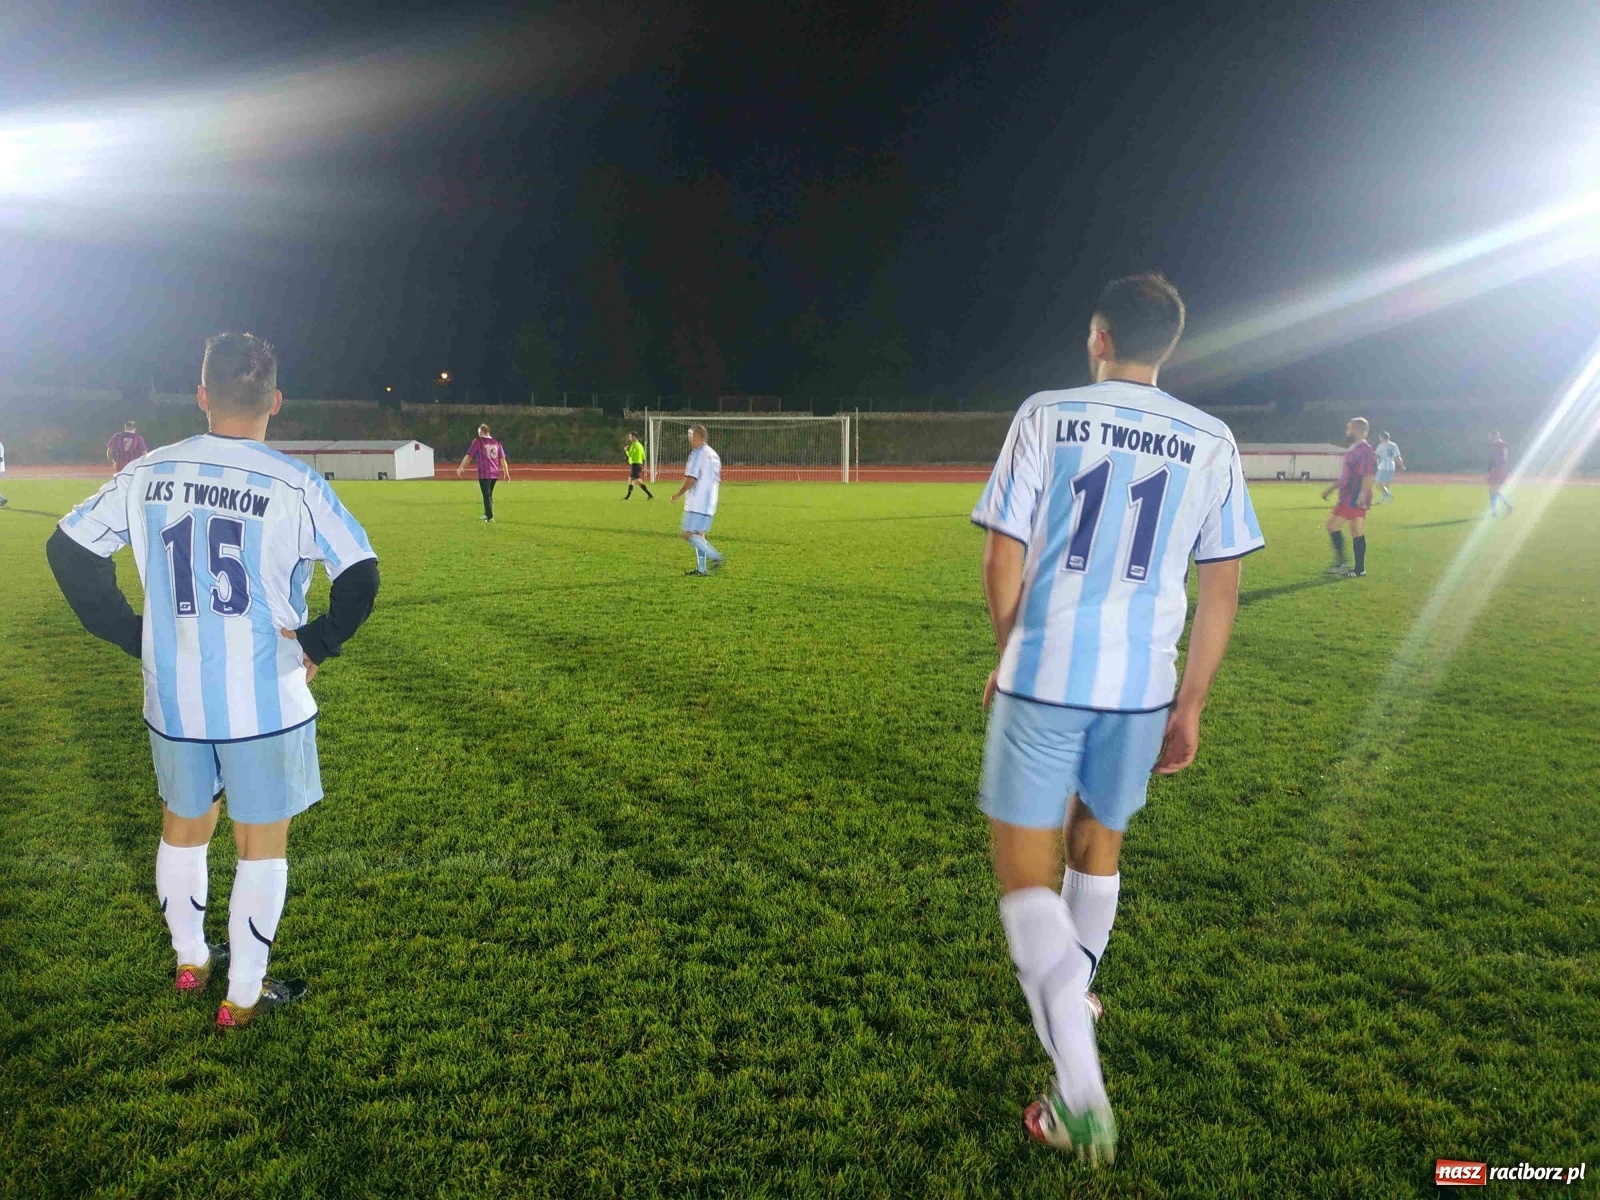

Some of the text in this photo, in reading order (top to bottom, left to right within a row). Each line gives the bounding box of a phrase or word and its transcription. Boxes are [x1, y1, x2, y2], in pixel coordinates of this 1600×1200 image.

[123, 437, 133, 451] 7
[1056, 419, 1196, 465] LKS TWORKÓW
[145, 481, 270, 518] LKS TWORKÓW
[1060, 454, 1171, 584] 11
[160, 510, 253, 618] 15
